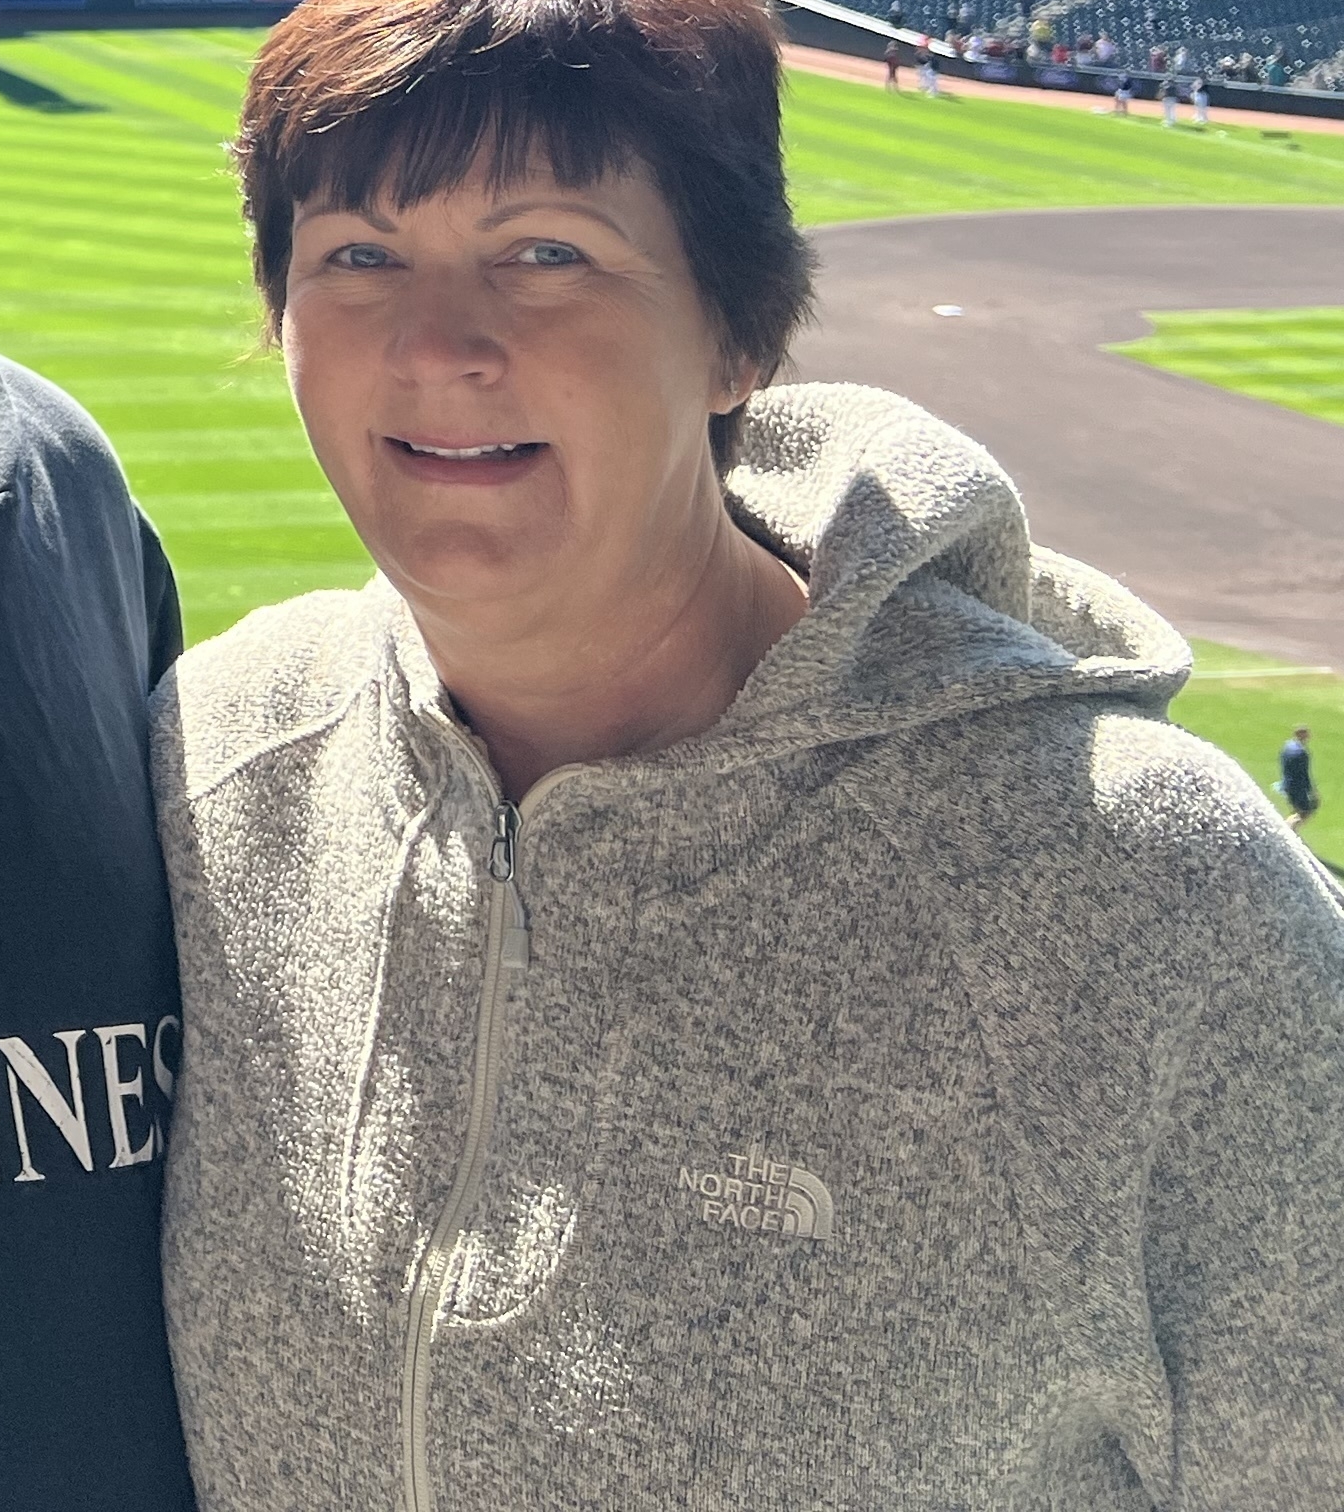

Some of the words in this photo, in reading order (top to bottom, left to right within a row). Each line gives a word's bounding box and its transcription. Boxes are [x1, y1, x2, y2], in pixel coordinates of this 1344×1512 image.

[728, 1153, 791, 1186] THE
[678, 1167, 786, 1210] NORTH
[702, 1199, 784, 1233] FACE
